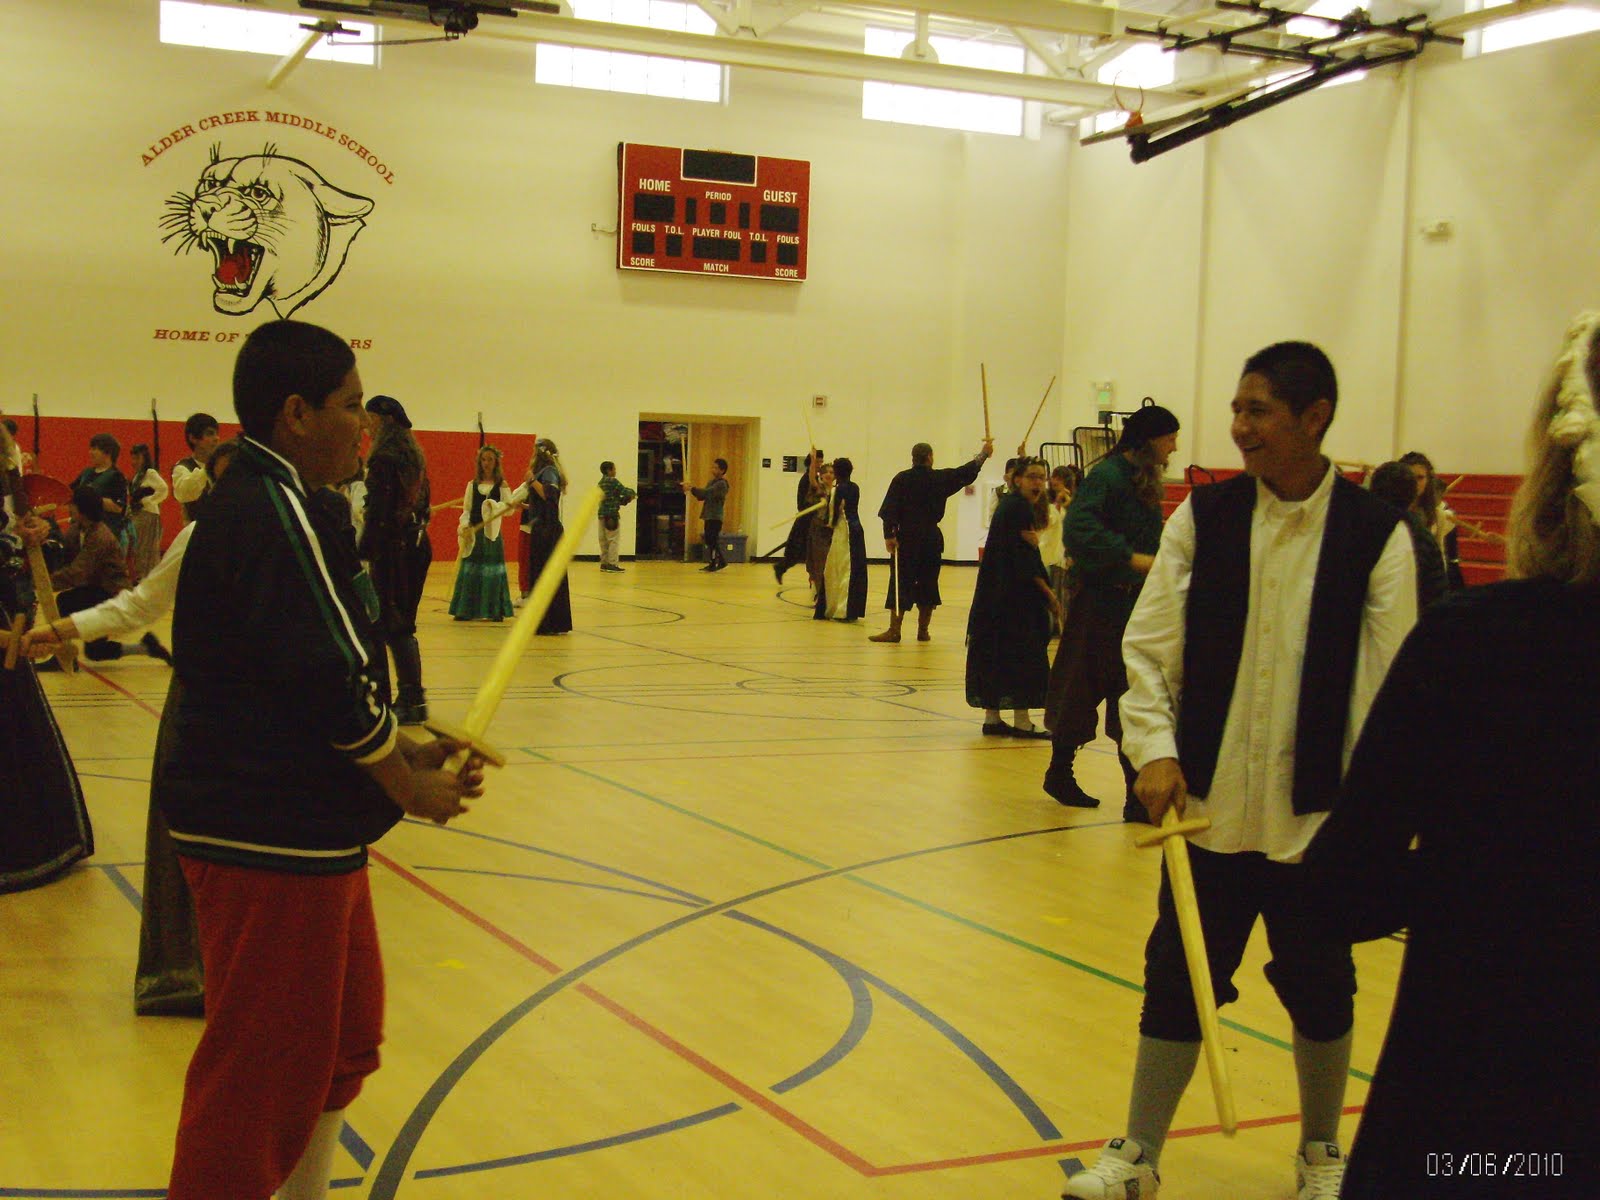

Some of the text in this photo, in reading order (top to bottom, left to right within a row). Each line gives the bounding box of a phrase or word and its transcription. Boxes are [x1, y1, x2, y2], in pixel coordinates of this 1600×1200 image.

[140, 110, 395, 186] ALDER CREEK MIDDLE SCHOOL
[638, 178, 671, 193] HOME
[705, 191, 732, 201] PERIOD
[763, 190, 798, 204] GUEST
[631, 222, 656, 233] FOULS
[664, 225, 685, 236] T.O.L.
[692, 227, 742, 240] PLAYER FOUL
[749, 232, 769, 242] T.O.L.
[776, 235, 800, 245] FOULS
[630, 257, 655, 267] SCORE
[703, 262, 729, 273] MATCH
[775, 268, 798, 278] SCORE
[153, 329, 211, 341] HOME
[214, 332, 241, 343] OF
